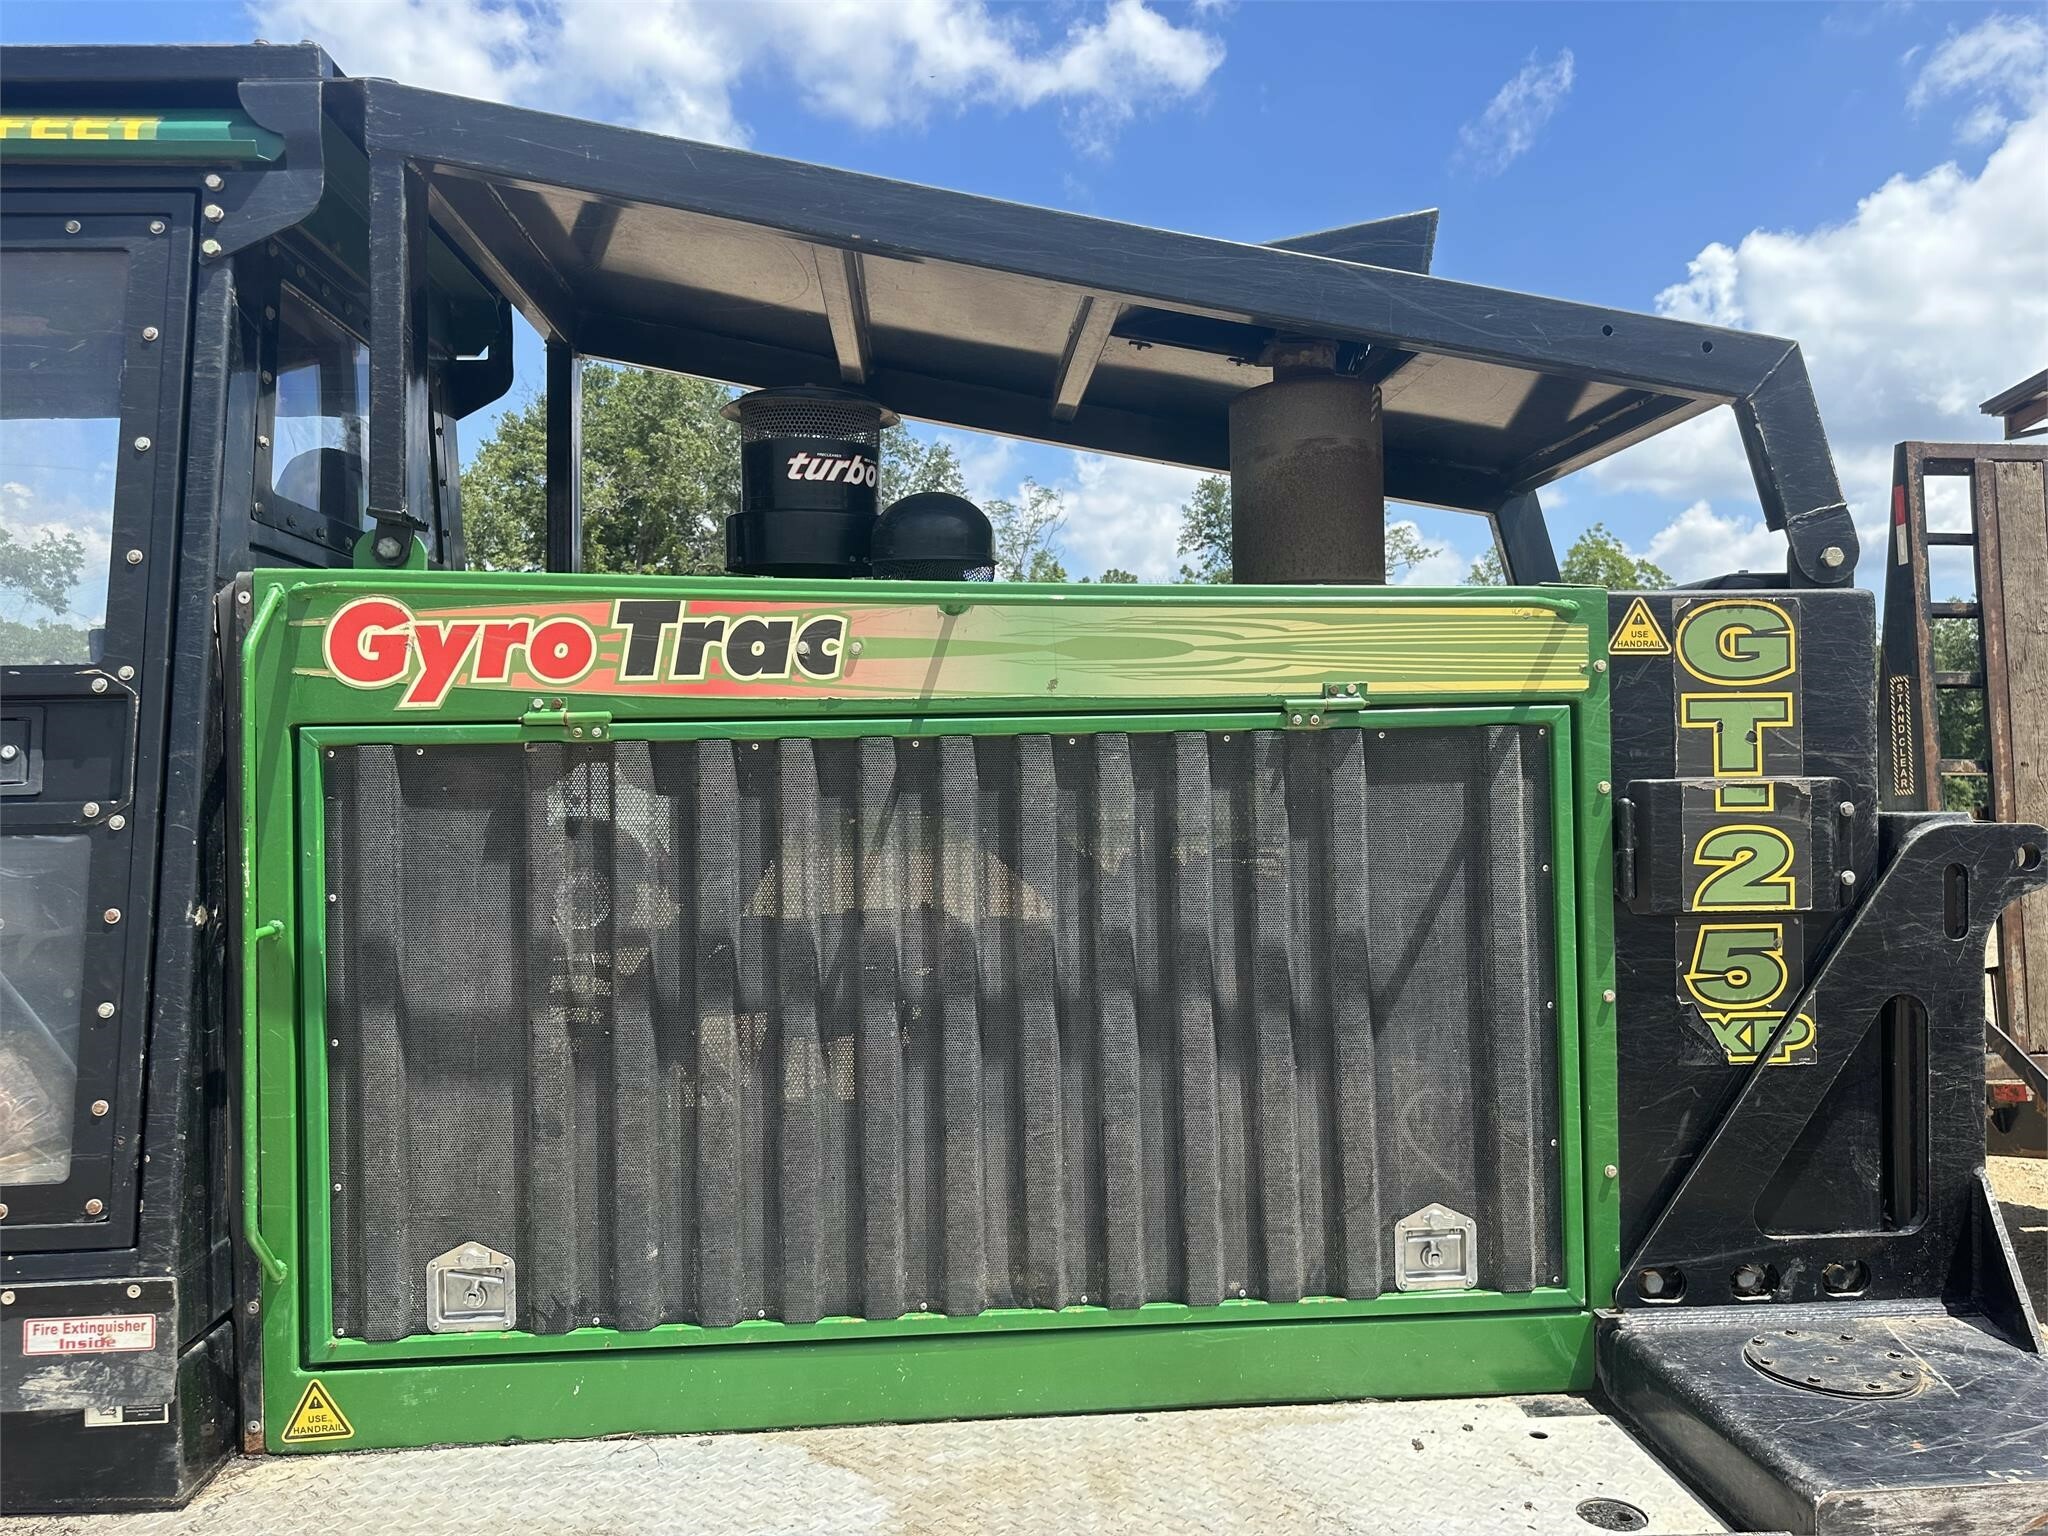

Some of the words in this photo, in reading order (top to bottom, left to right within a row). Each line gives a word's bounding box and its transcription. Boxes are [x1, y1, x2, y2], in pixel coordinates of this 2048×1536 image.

[787, 451, 877, 488] turbo
[1630, 630, 1649, 638] USE
[1616, 640, 1663, 648] HANDRAIL
[324, 596, 599, 712] Gyro
[611, 598, 850, 683] Trac
[1895, 683, 1906, 734] STAND
[1898, 737, 1909, 788] CLEAR
[32, 1323, 58, 1336] Fire
[63, 1319, 147, 1337] Extinguisher
[58, 1337, 117, 1350] Inside
[307, 1414, 328, 1424] USE
[293, 1423, 345, 1435] HANDRAIL
